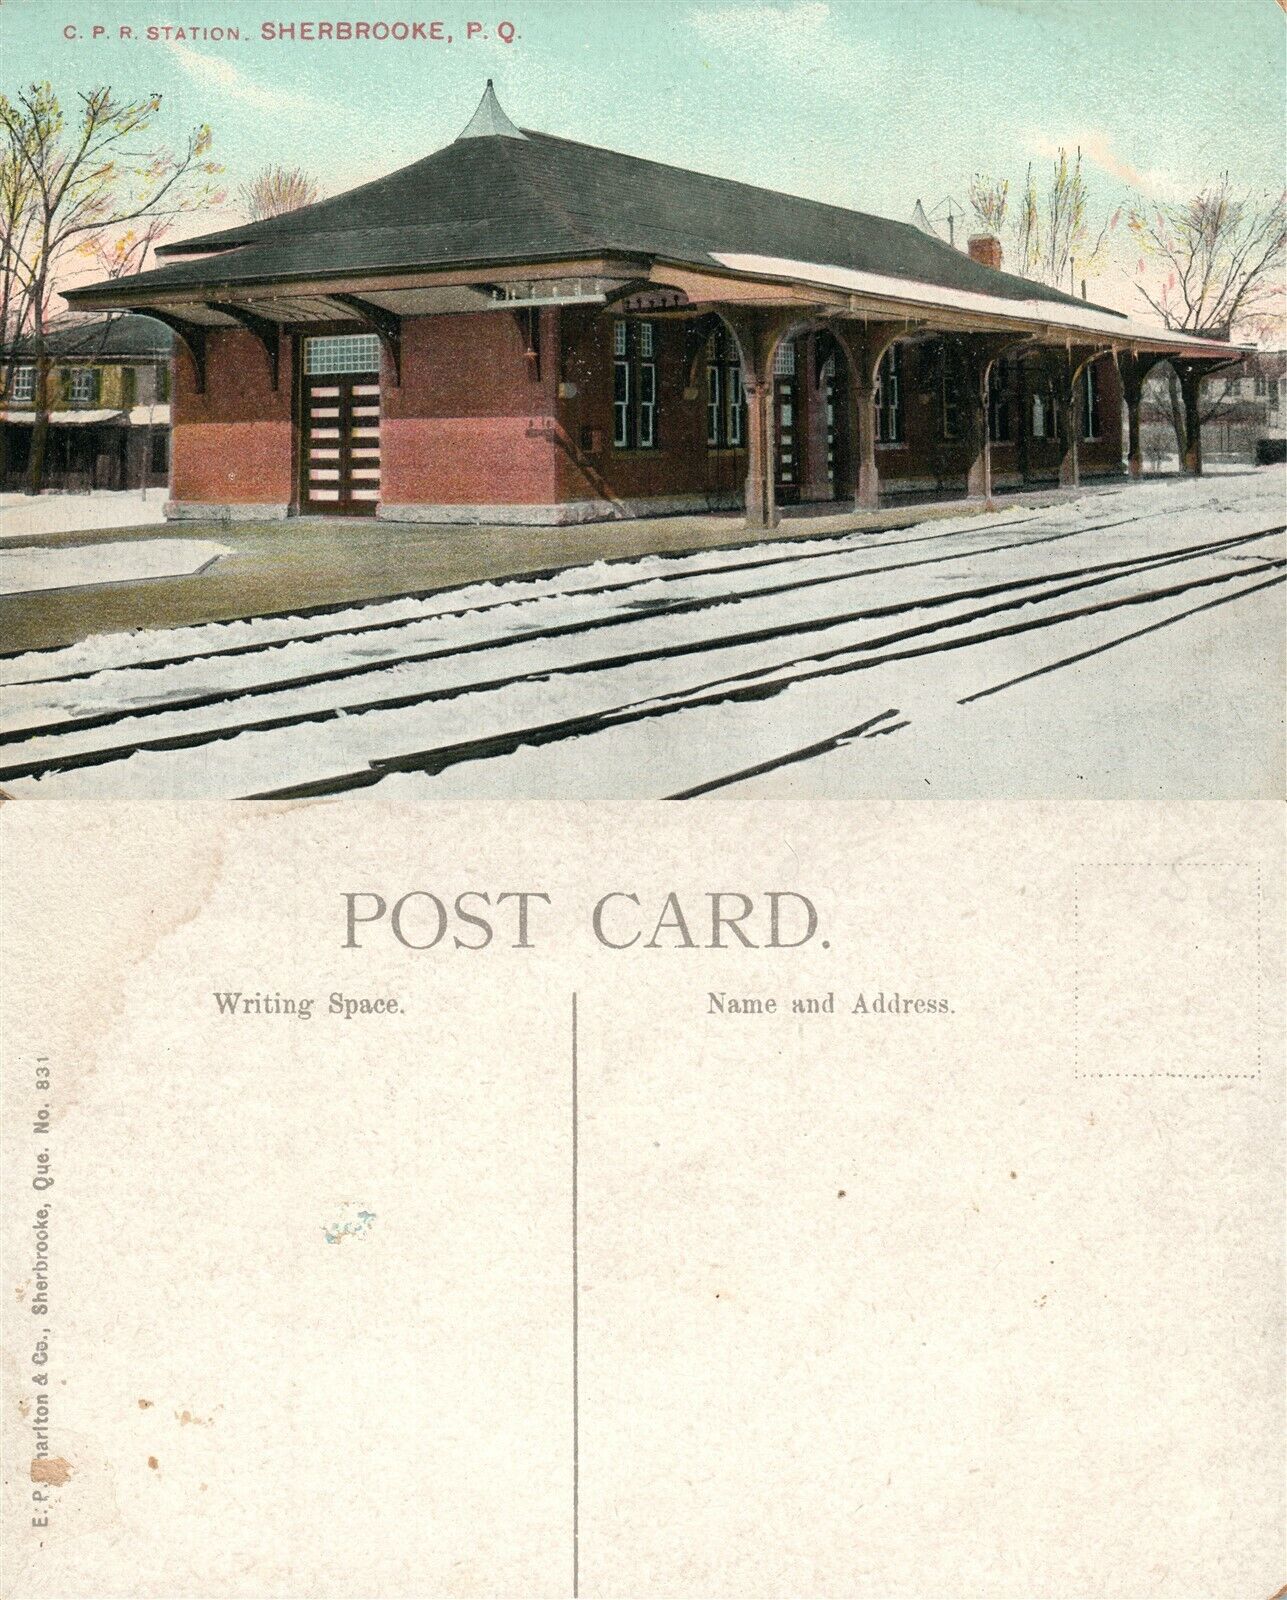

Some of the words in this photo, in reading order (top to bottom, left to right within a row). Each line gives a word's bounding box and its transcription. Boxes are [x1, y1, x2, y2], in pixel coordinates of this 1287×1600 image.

[63, 25, 84, 40] C.
[92, 25, 110, 40] P.
[119, 25, 139, 40] R.
[147, 25, 249, 42] STATION.
[261, 21, 453, 44] SHERBROOKE,
[466, 21, 488, 41] P.
[497, 21, 522, 45] Q.
[341, 892, 551, 950] POST
[592, 891, 831, 951] CARD.
[213, 992, 314, 1020] Writing
[328, 992, 406, 1020] Space.
[708, 992, 777, 1014] Name
[792, 992, 834, 1014] and
[852, 992, 956, 1014] Address.
[36, 1056, 51, 1091] 831
[33, 1104, 50, 1135] No.
[32, 1148, 55, 1191] Que.
[31, 1203, 51, 1316] Sherbrooke,
[31, 1374, 49, 1387] &
[31, 1483, 49, 1502] P.
